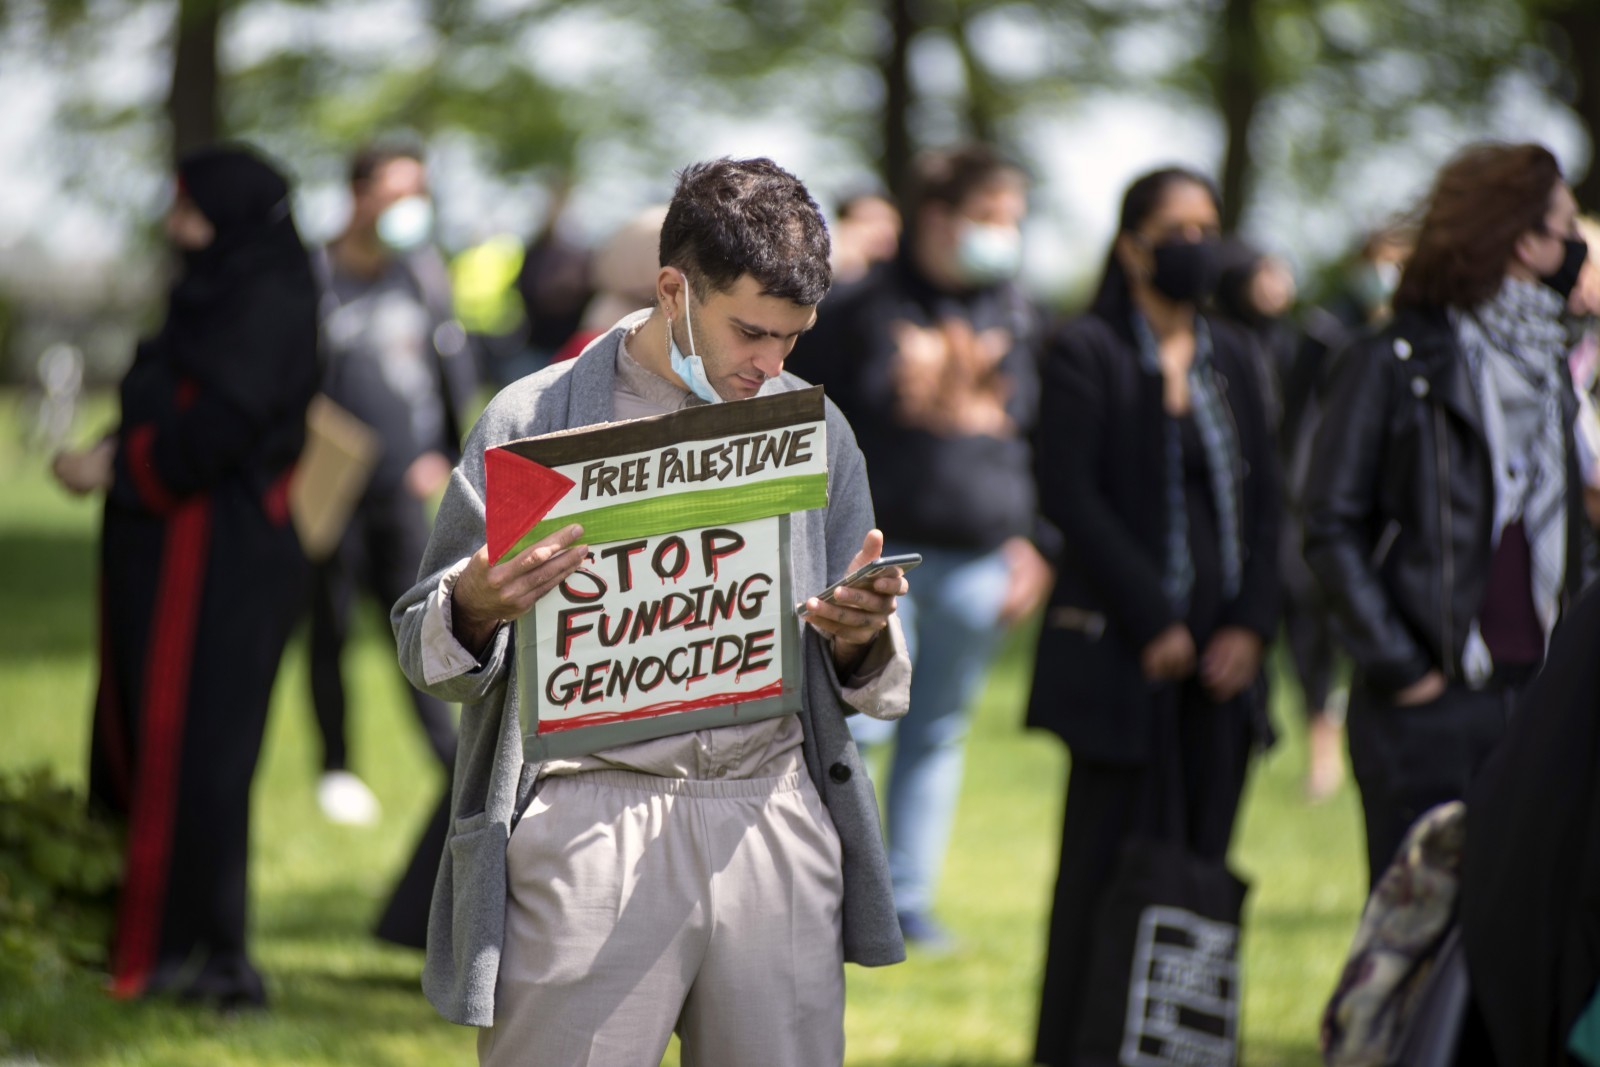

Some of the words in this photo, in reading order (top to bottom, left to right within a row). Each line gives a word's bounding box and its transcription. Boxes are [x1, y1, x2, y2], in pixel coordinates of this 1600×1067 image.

[580, 456, 652, 500] FREE
[657, 427, 816, 488] PALESTINE
[558, 529, 745, 604] STOP
[556, 573, 773, 660] FUNDING
[545, 629, 775, 708] GENOCIDE
